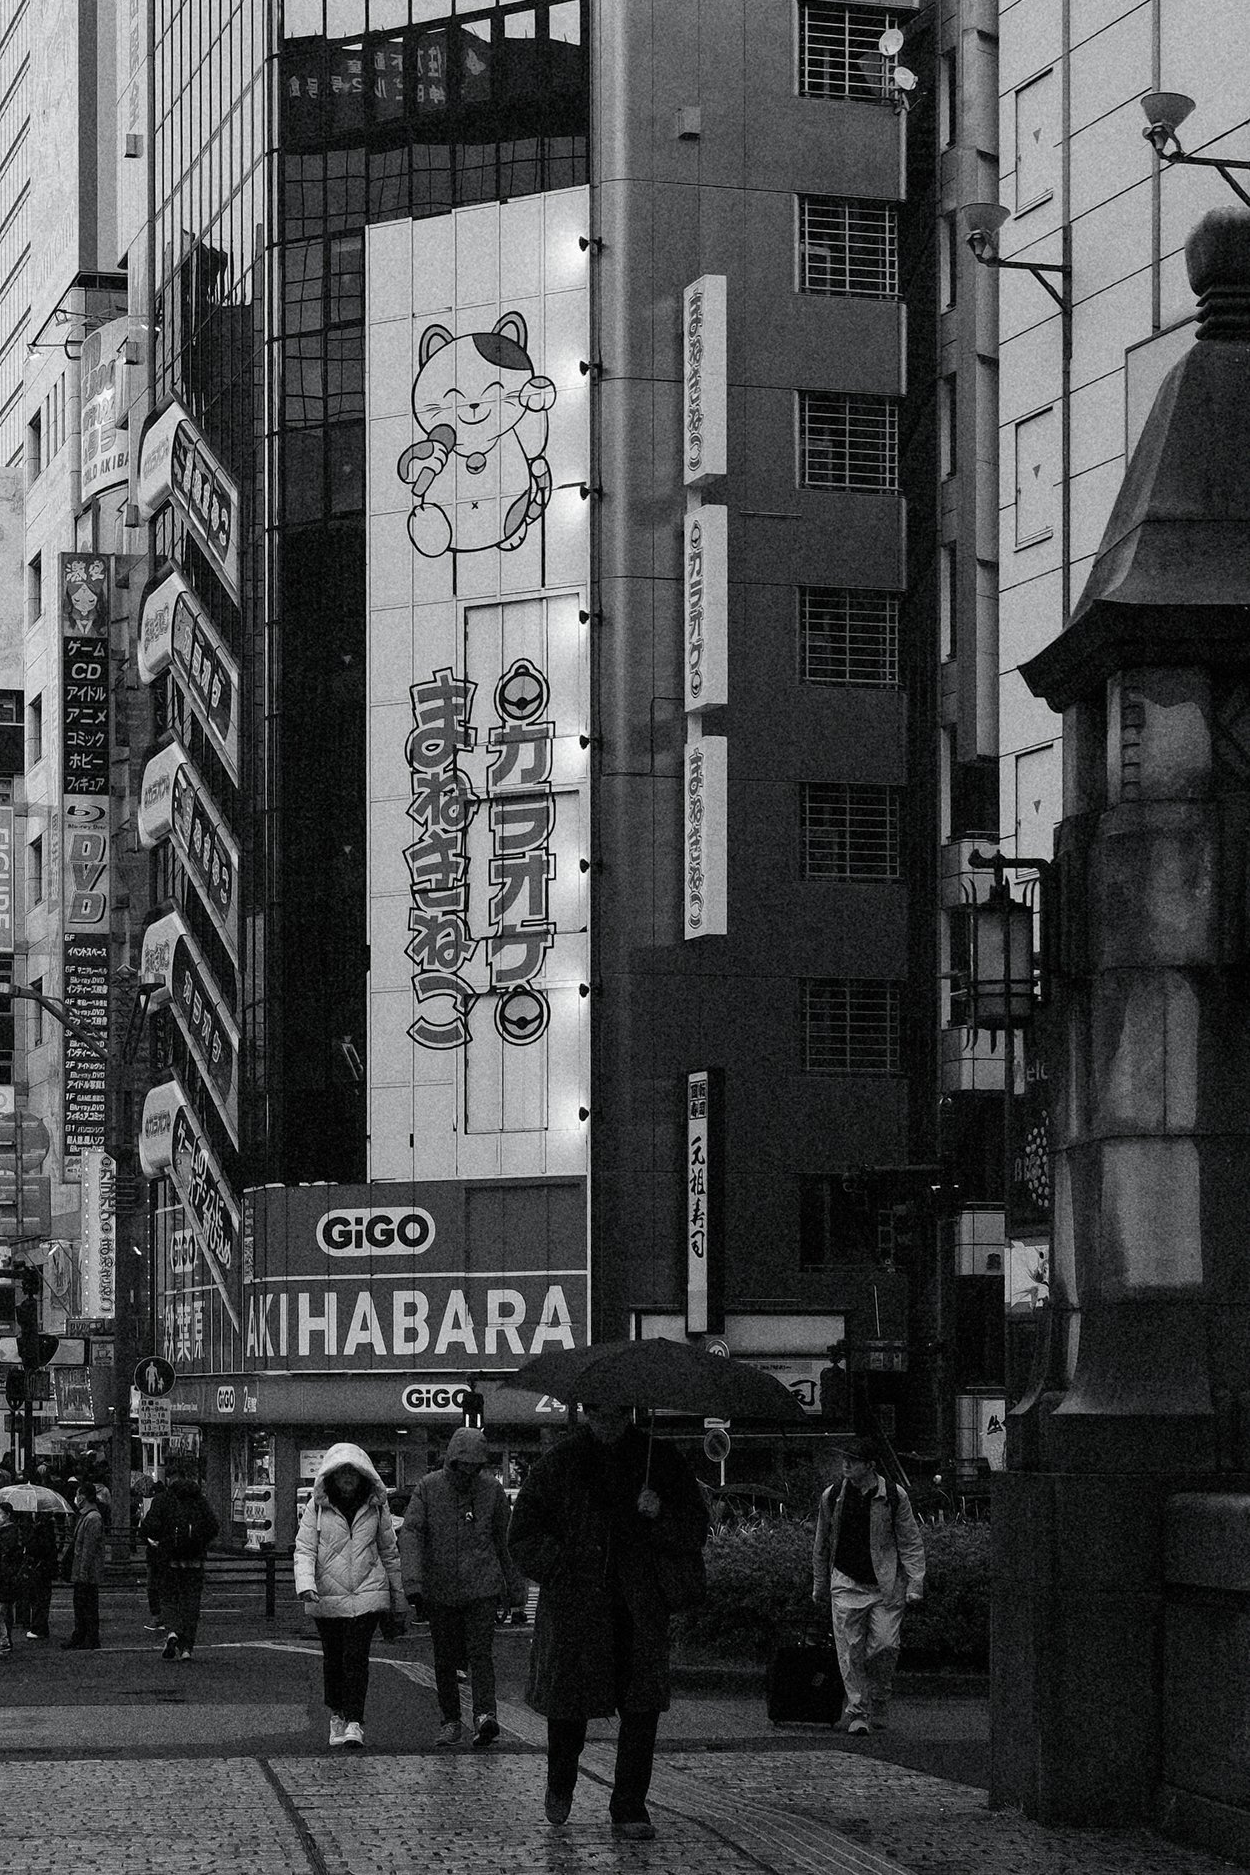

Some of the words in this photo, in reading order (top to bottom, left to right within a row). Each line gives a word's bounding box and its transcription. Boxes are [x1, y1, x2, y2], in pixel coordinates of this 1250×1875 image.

[686, 550, 705, 673] カラオケ
[67, 640, 106, 656] ゲーム
[71, 662, 102, 679] CD
[66, 686, 107, 702] アイドル
[66, 708, 107, 724] アニメ
[67, 731, 105, 747] コミック
[68, 753, 104, 769] ホビー
[66, 776, 105, 792] フィギュア
[405, 667, 478, 1049] まねきねこ
[487, 720, 556, 993] カラオケ
[686, 747, 705, 930] まねきねこ
[68, 833, 107, 924] DVD
[100, 1169, 115, 1221] カラオケ
[322, 1212, 431, 1250] GiGO
[100, 1238, 113, 1313] まねきねこ
[164, 1300, 205, 1362] 秋葉原
[246, 1284, 577, 1359] AKIHABARA
